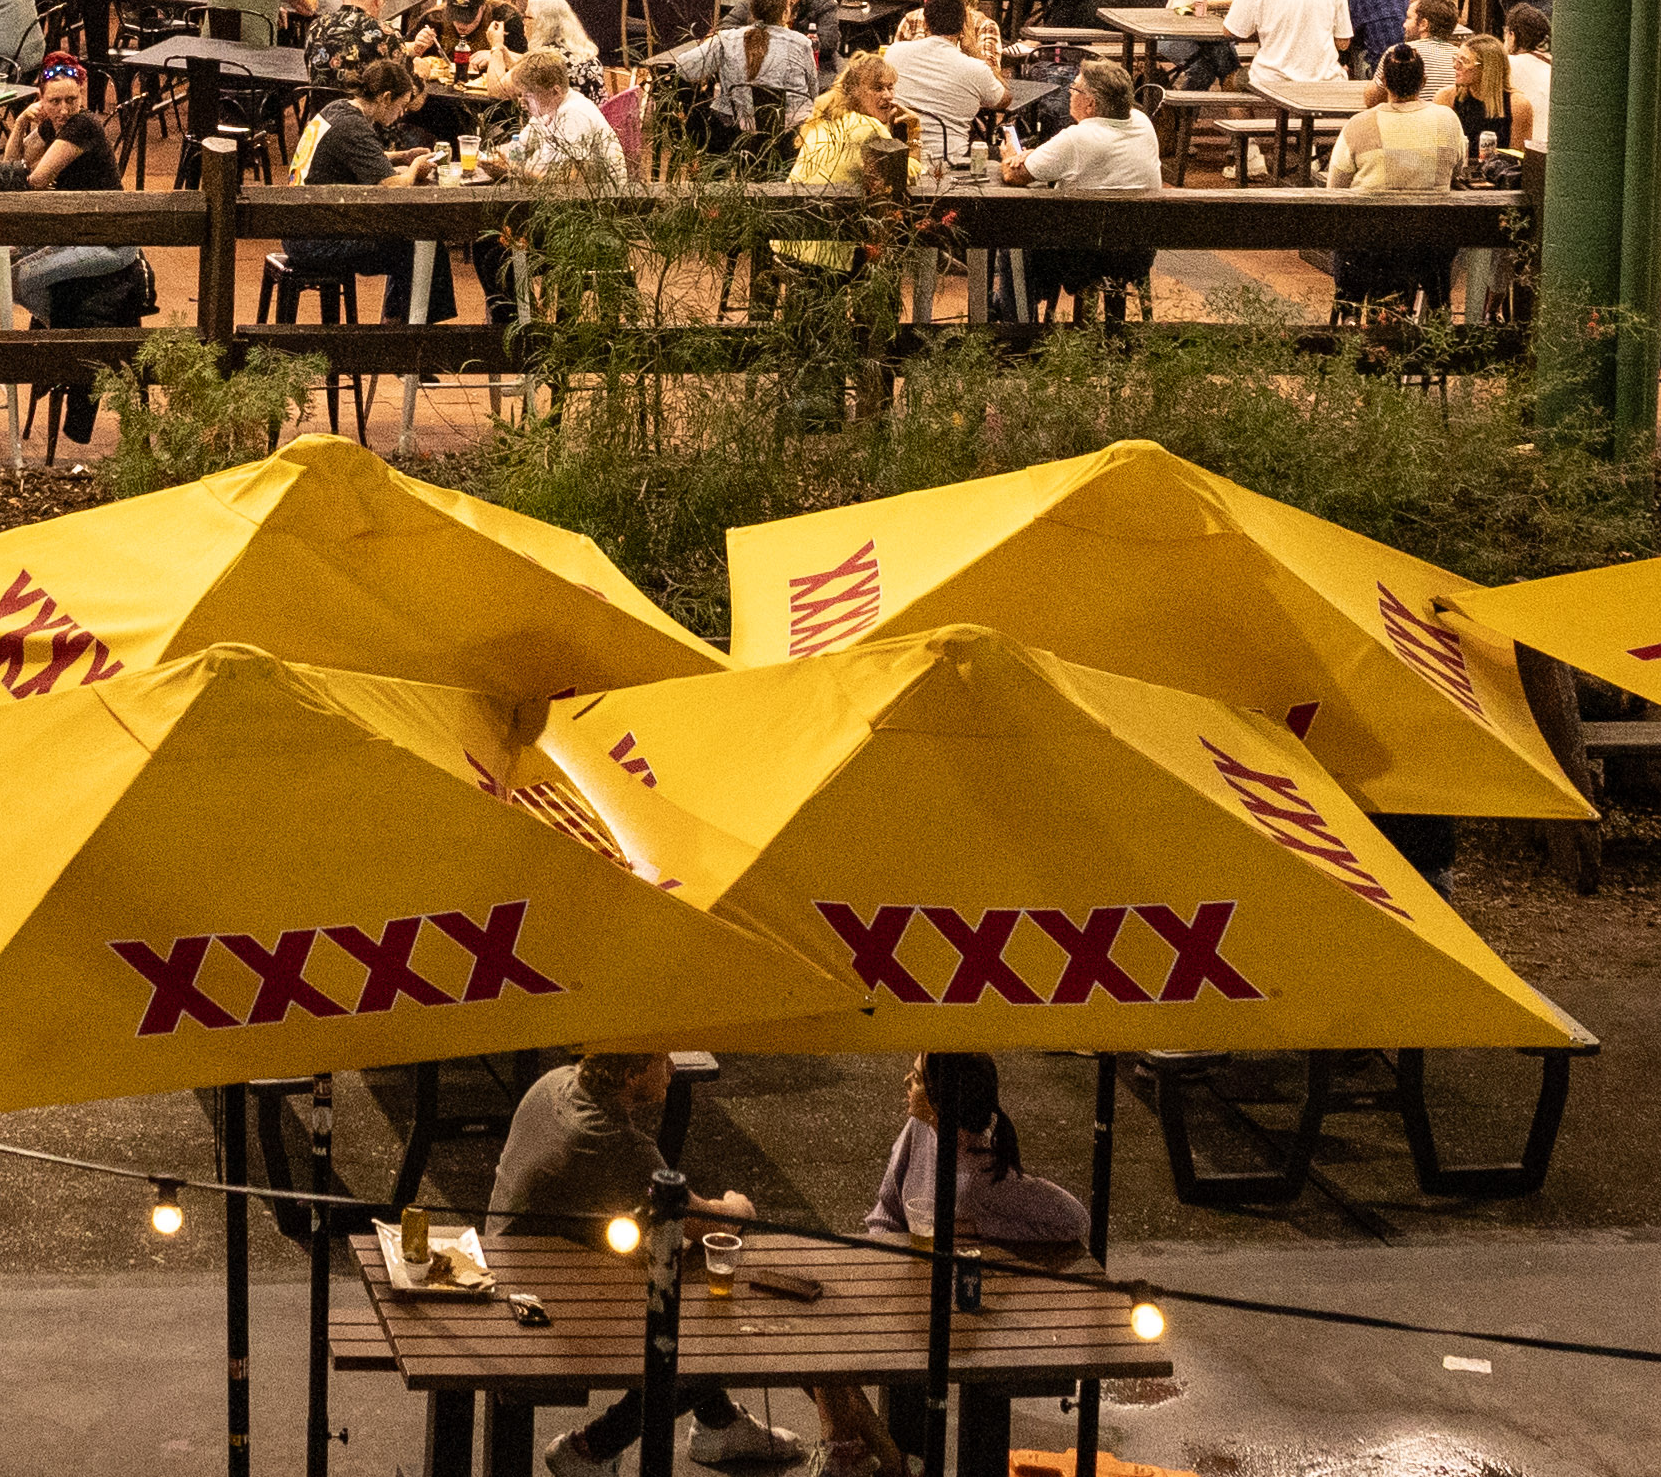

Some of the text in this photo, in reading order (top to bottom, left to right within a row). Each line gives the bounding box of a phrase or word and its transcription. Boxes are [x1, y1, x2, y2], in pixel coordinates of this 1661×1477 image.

[788, 537, 881, 659] XXXX
[1376, 580, 1485, 720] XXXX
[108, 898, 571, 1039] XXXX
[811, 898, 1269, 1007] XXXX
